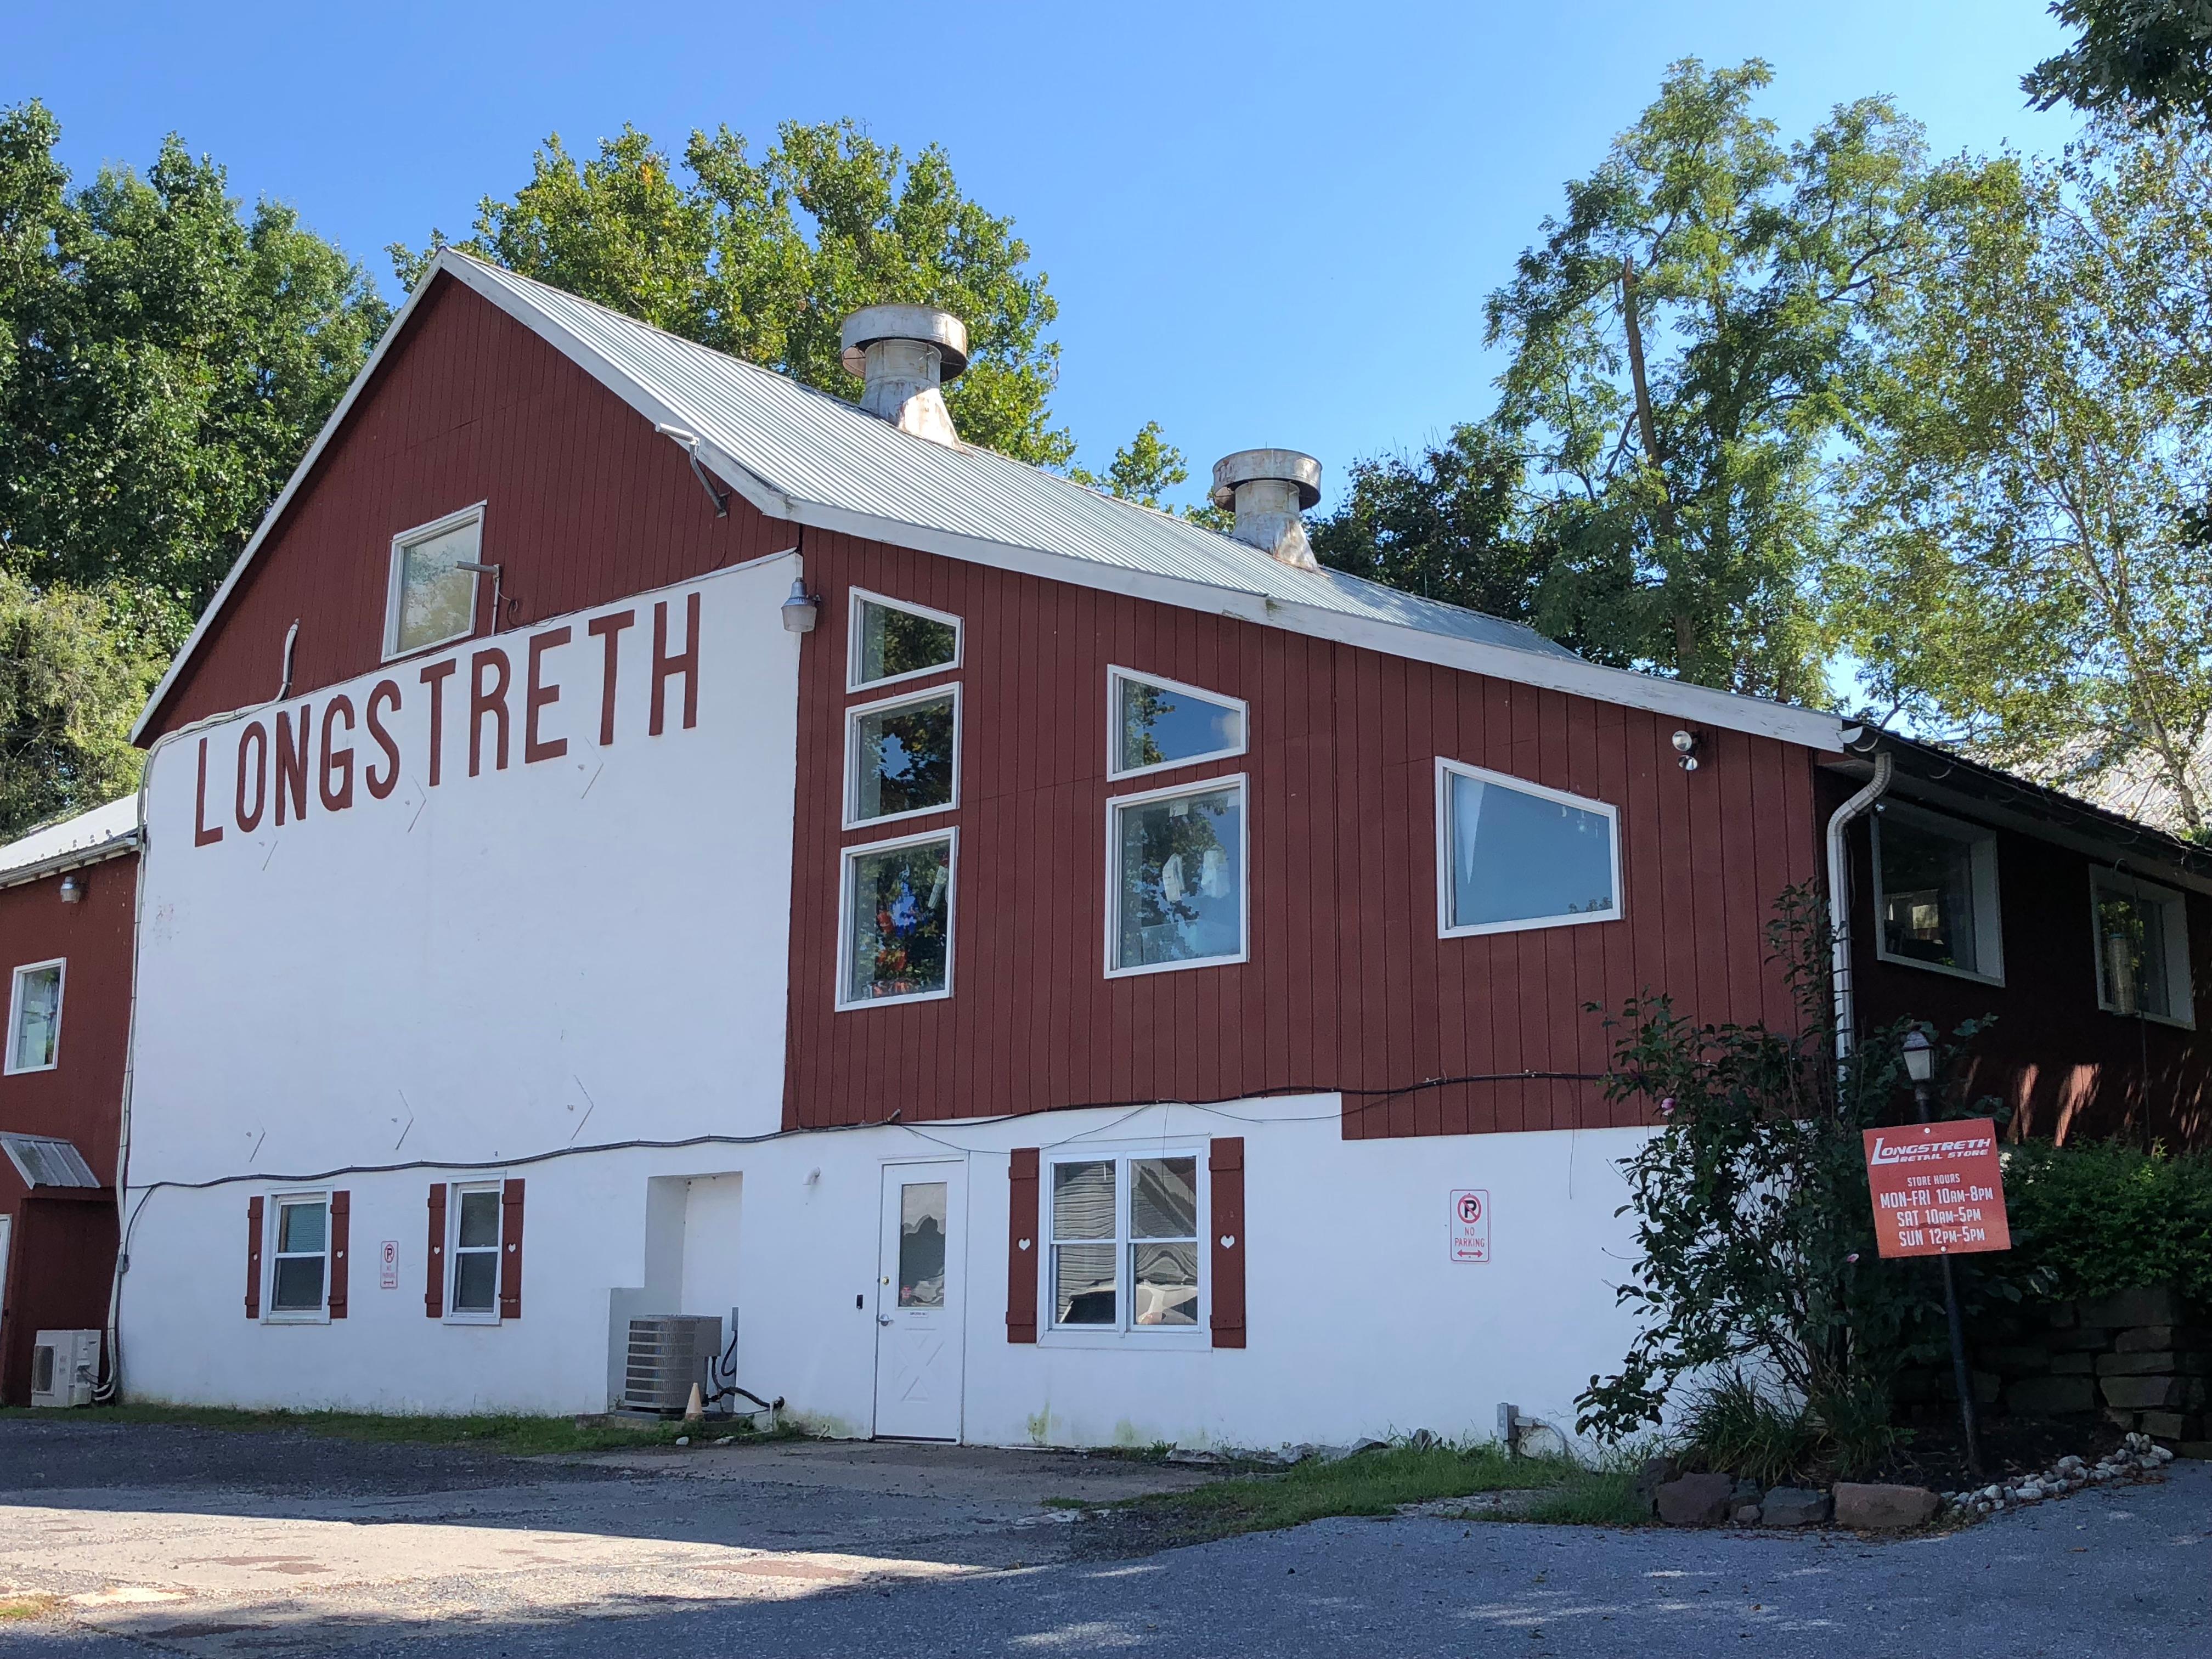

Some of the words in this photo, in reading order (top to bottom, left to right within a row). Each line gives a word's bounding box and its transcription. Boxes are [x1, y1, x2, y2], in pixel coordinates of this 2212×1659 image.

[195, 592, 700, 848] LONGSTRETH
[1871, 1137, 1991, 1165] LONGSTRETH
[1900, 1153, 1943, 1163] RETAIL
[1948, 1149, 1988, 1159] STORE
[1907, 1176, 1932, 1187] STORE
[1933, 1173, 1960, 1185] HOURS
[1880, 1189, 1931, 1209] MON-FRI
[1936, 1185, 1994, 1204] 10AM-8PM
[1897, 1210, 1919, 1227] SAT
[1925, 1206, 1982, 1225] 10AM-5PM
[1464, 1227, 1475, 1236] NO
[1899, 1229, 1924, 1247] SUN
[1929, 1226, 1985, 1245] 12PM-5PM
[1454, 1238, 1485, 1248] PARKING
